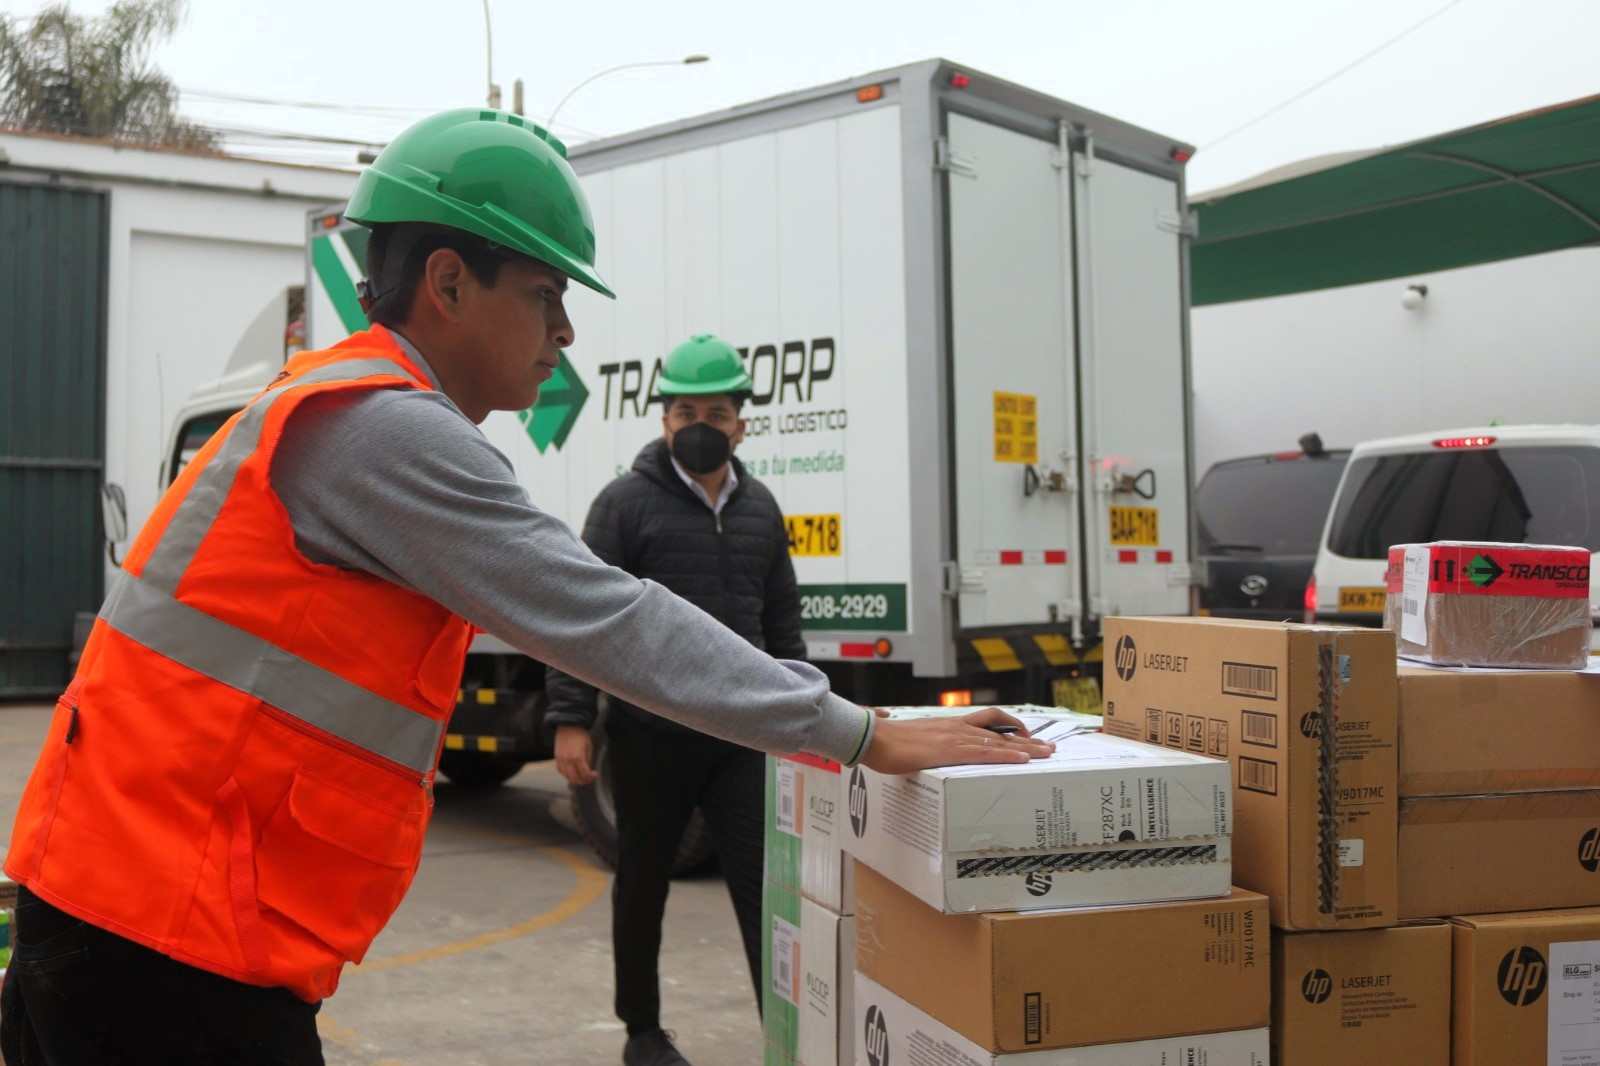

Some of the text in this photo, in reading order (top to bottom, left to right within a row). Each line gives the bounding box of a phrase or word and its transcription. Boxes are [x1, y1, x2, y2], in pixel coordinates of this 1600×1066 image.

[789, 451, 845, 473] medida
[800, 595, 888, 619] 208-2929
[1115, 634, 1189, 682] hp LASERJET
[1169, 716, 1181, 735] 16
[1190, 720, 1202, 738] 12
[1244, 910, 1254, 968] W9017MC
[1302, 968, 1391, 1004] hp LASERJET
[1497, 946, 1547, 1007] hp
